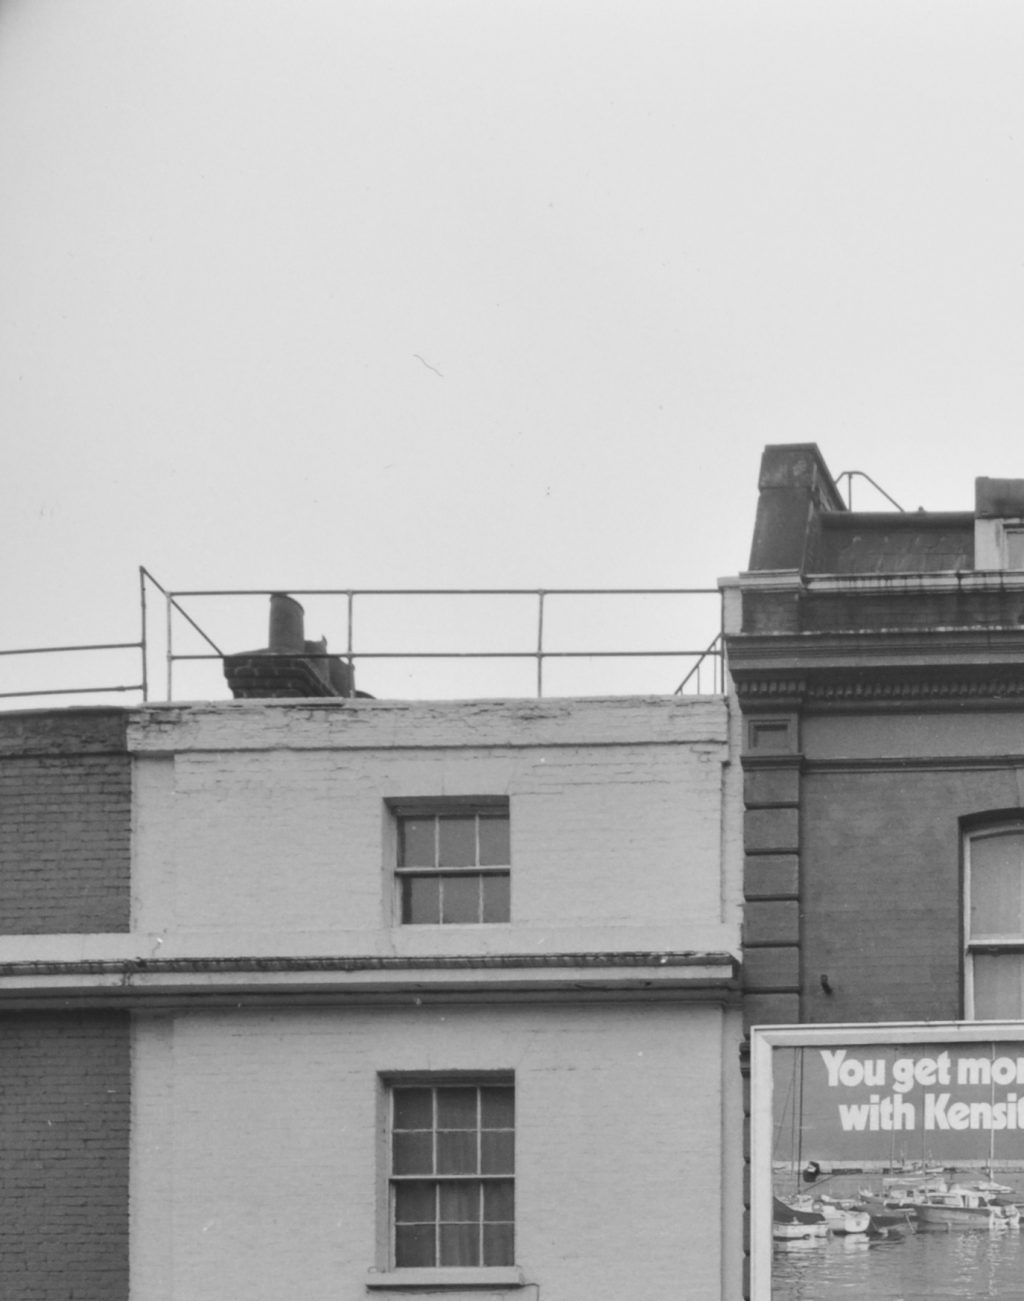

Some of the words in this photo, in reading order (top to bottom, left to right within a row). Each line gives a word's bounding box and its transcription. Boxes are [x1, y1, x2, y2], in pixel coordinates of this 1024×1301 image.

[820, 1050, 886, 1087] You
[893, 1051, 952, 1093] get
[838, 1094, 916, 1132] with
